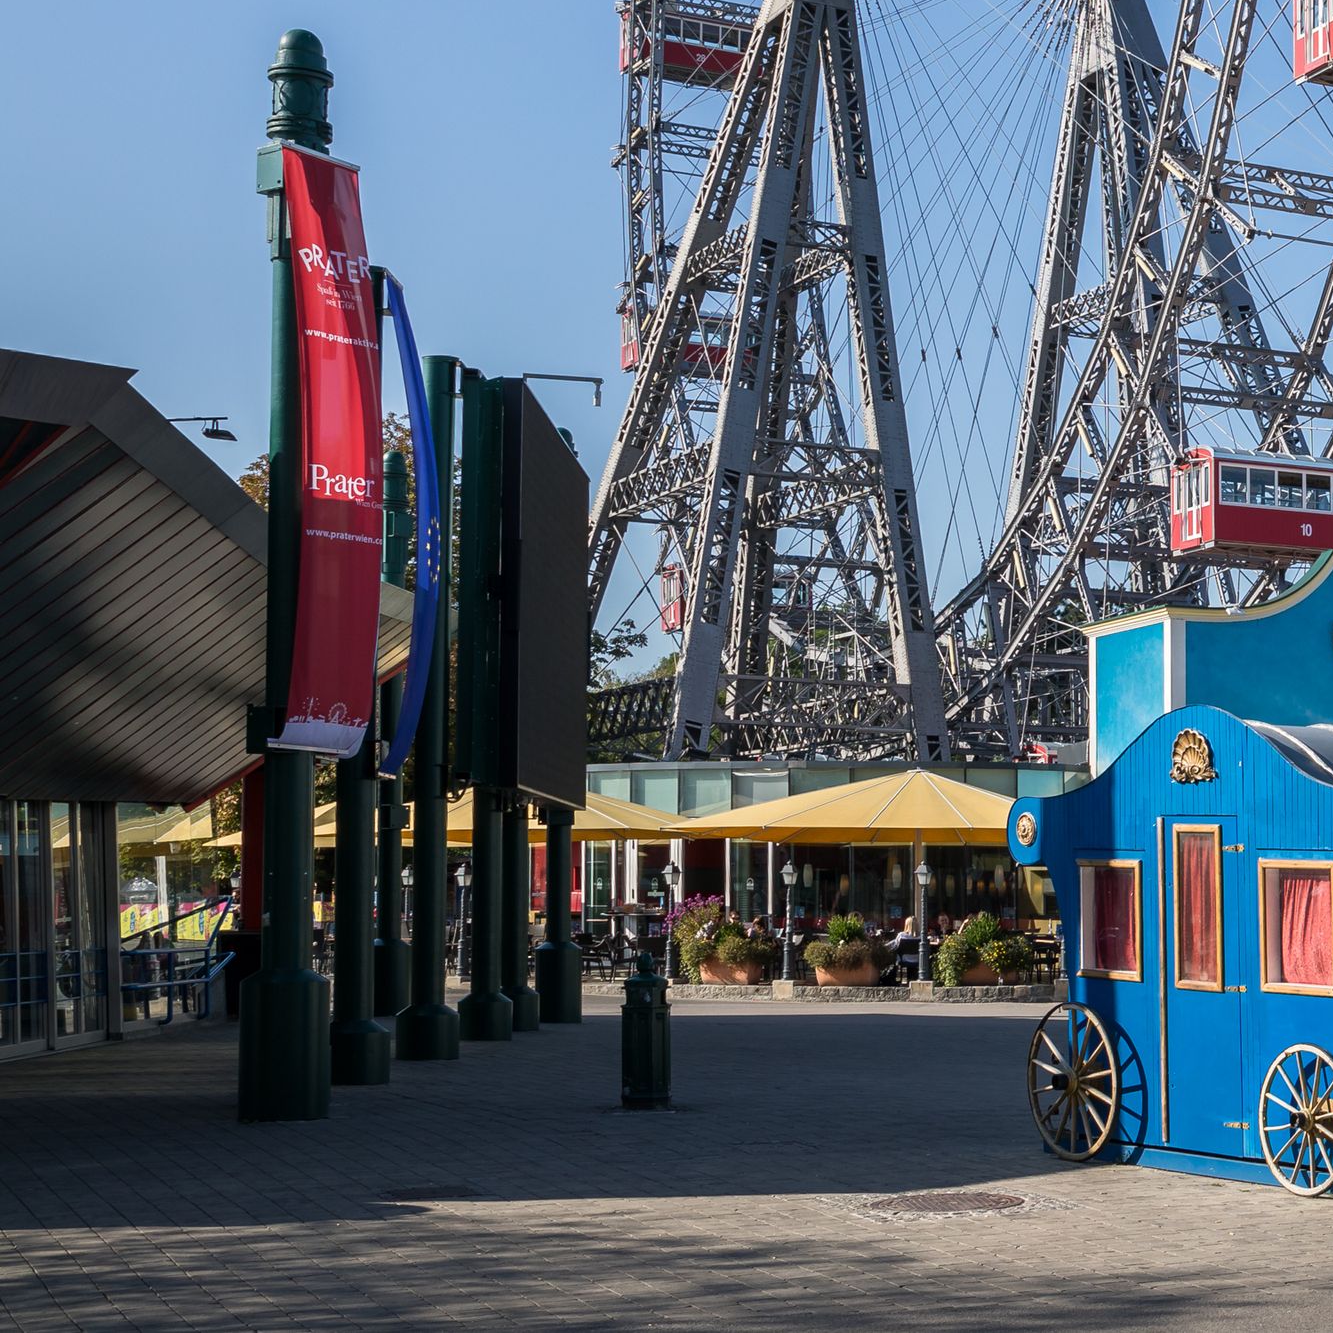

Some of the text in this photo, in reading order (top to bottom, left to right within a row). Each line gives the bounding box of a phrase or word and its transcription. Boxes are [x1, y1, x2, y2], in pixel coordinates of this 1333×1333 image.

[298, 243, 372, 283] PRATER
[308, 463, 375, 499] Prater
[306, 528, 383, 545] www.praterwien.co
[1300, 524, 1312, 536] 10
